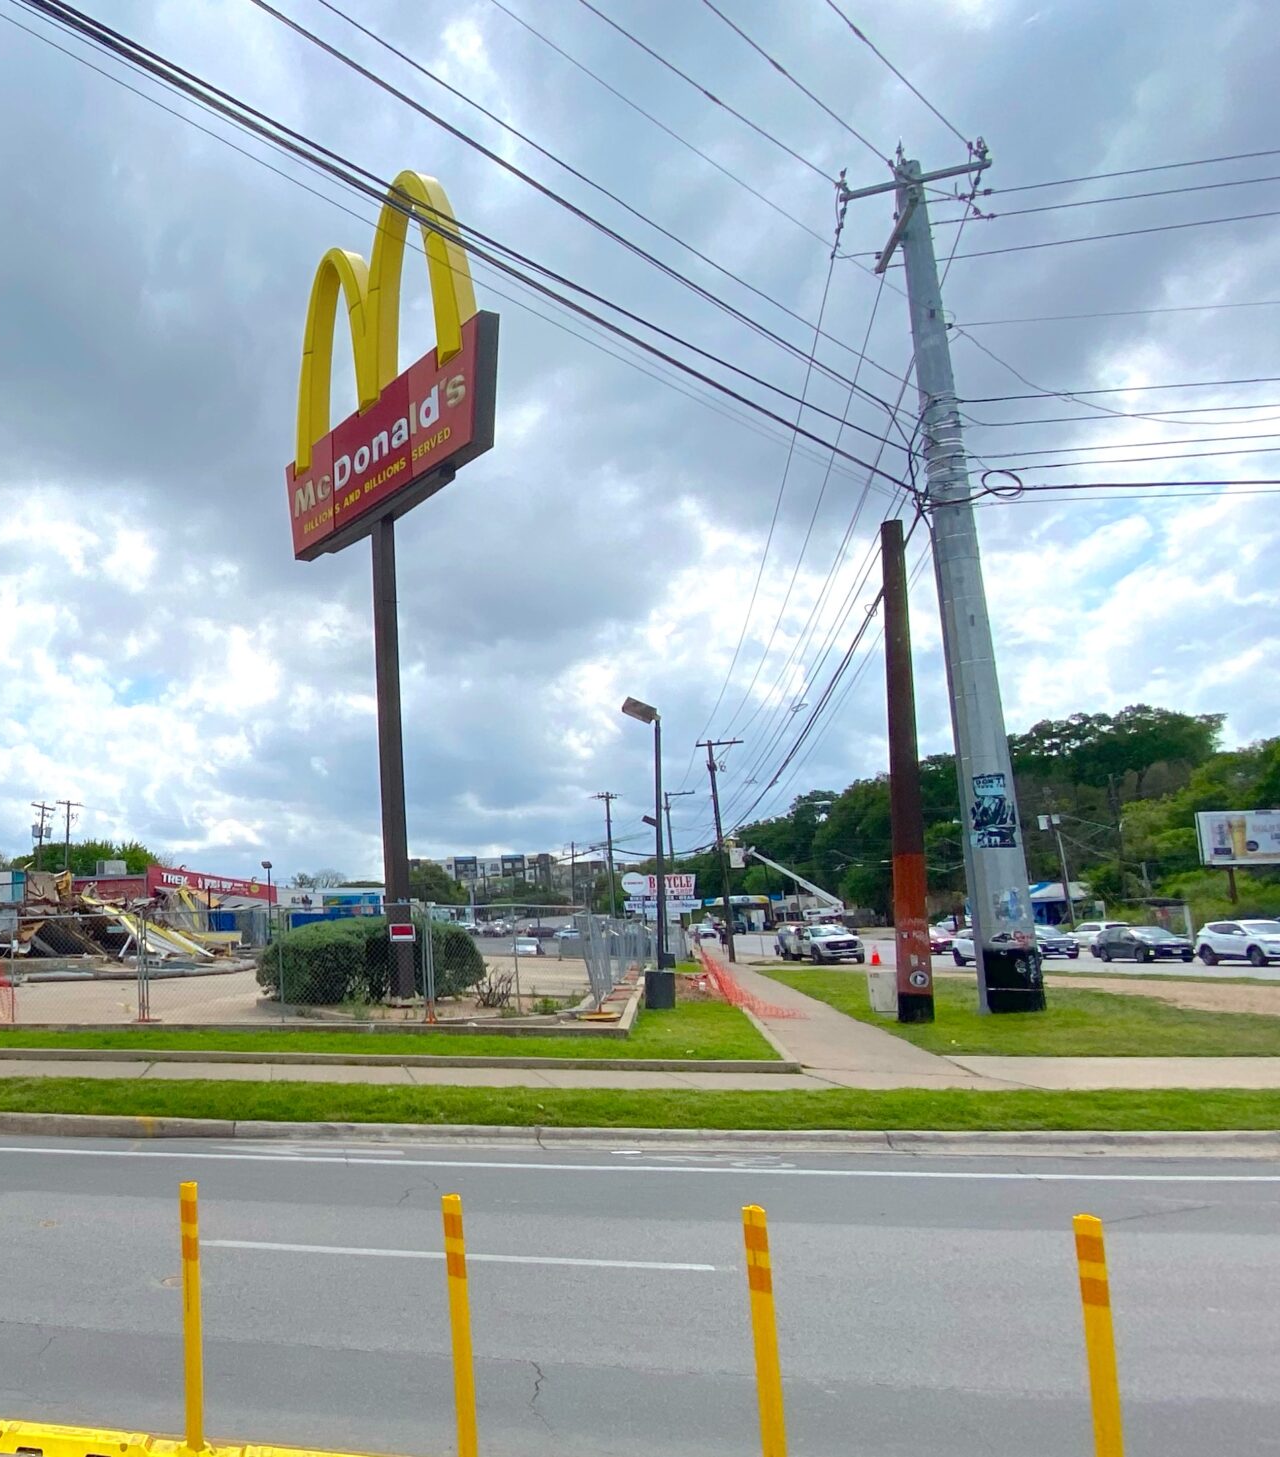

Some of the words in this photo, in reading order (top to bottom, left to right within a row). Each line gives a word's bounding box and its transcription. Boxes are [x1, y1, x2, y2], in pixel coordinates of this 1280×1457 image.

[294, 374, 466, 517] McDonald's
[303, 504, 341, 534] BILLIONS
[343, 489, 361, 509] AND
[364, 457, 407, 493] BILLIONS
[411, 427, 451, 462] SERVED
[648, 876, 693, 889] BYCLE
